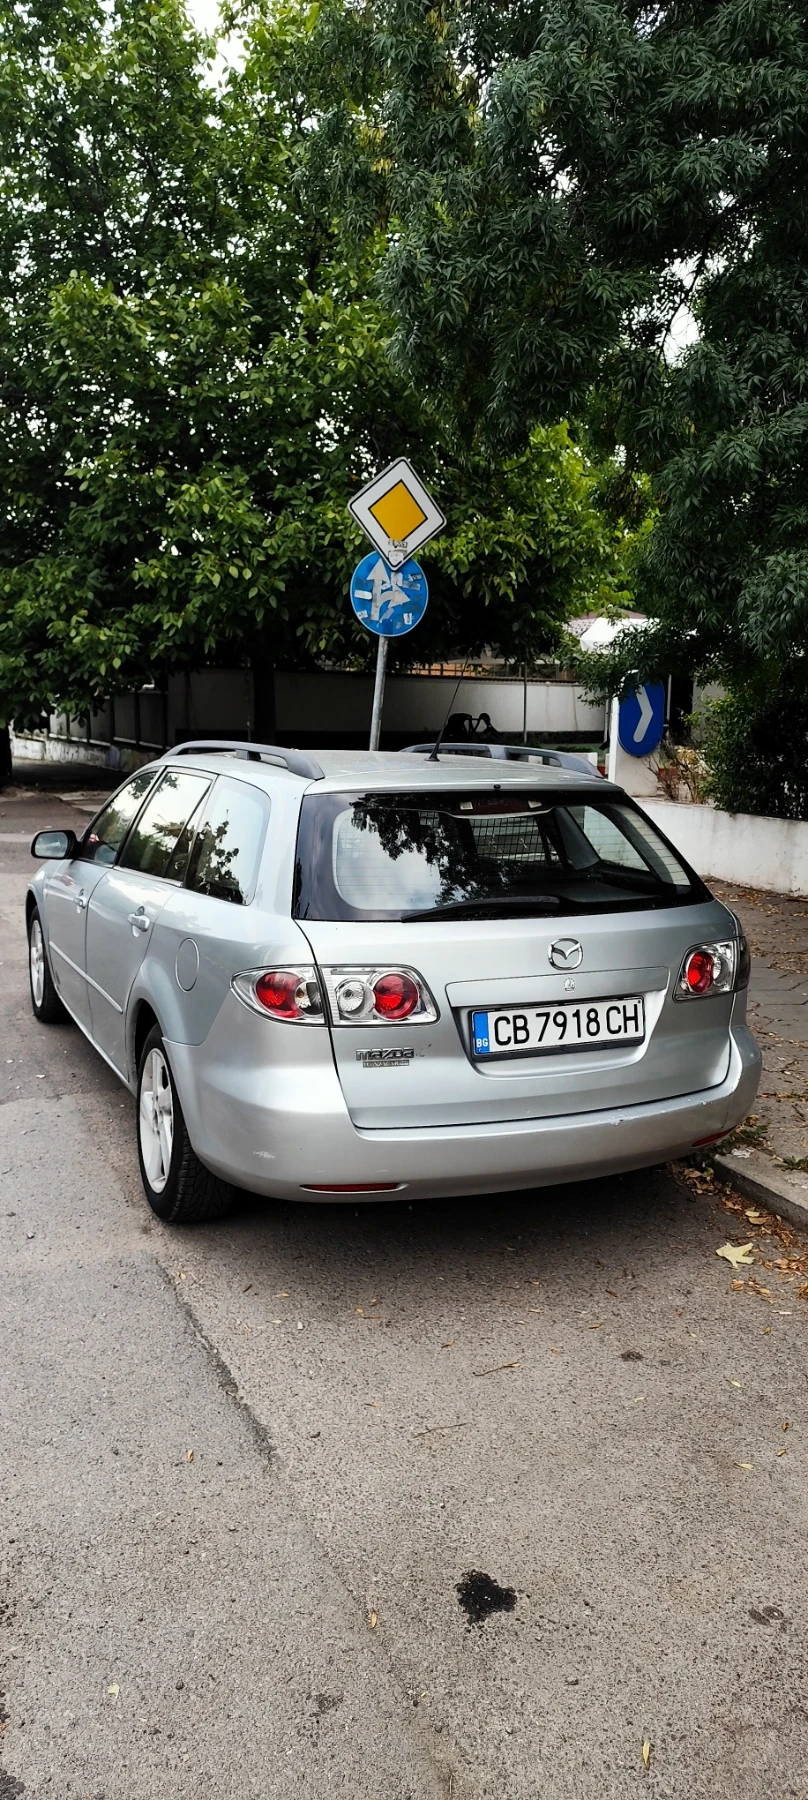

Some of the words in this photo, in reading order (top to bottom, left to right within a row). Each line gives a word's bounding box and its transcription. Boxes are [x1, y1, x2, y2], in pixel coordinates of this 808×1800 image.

[494, 1014, 530, 1046] CB
[535, 1007, 600, 1042] 7918
[606, 1003, 639, 1035] CH
[476, 1037, 489, 1048] BG
[355, 1047, 415, 1061] mazda
